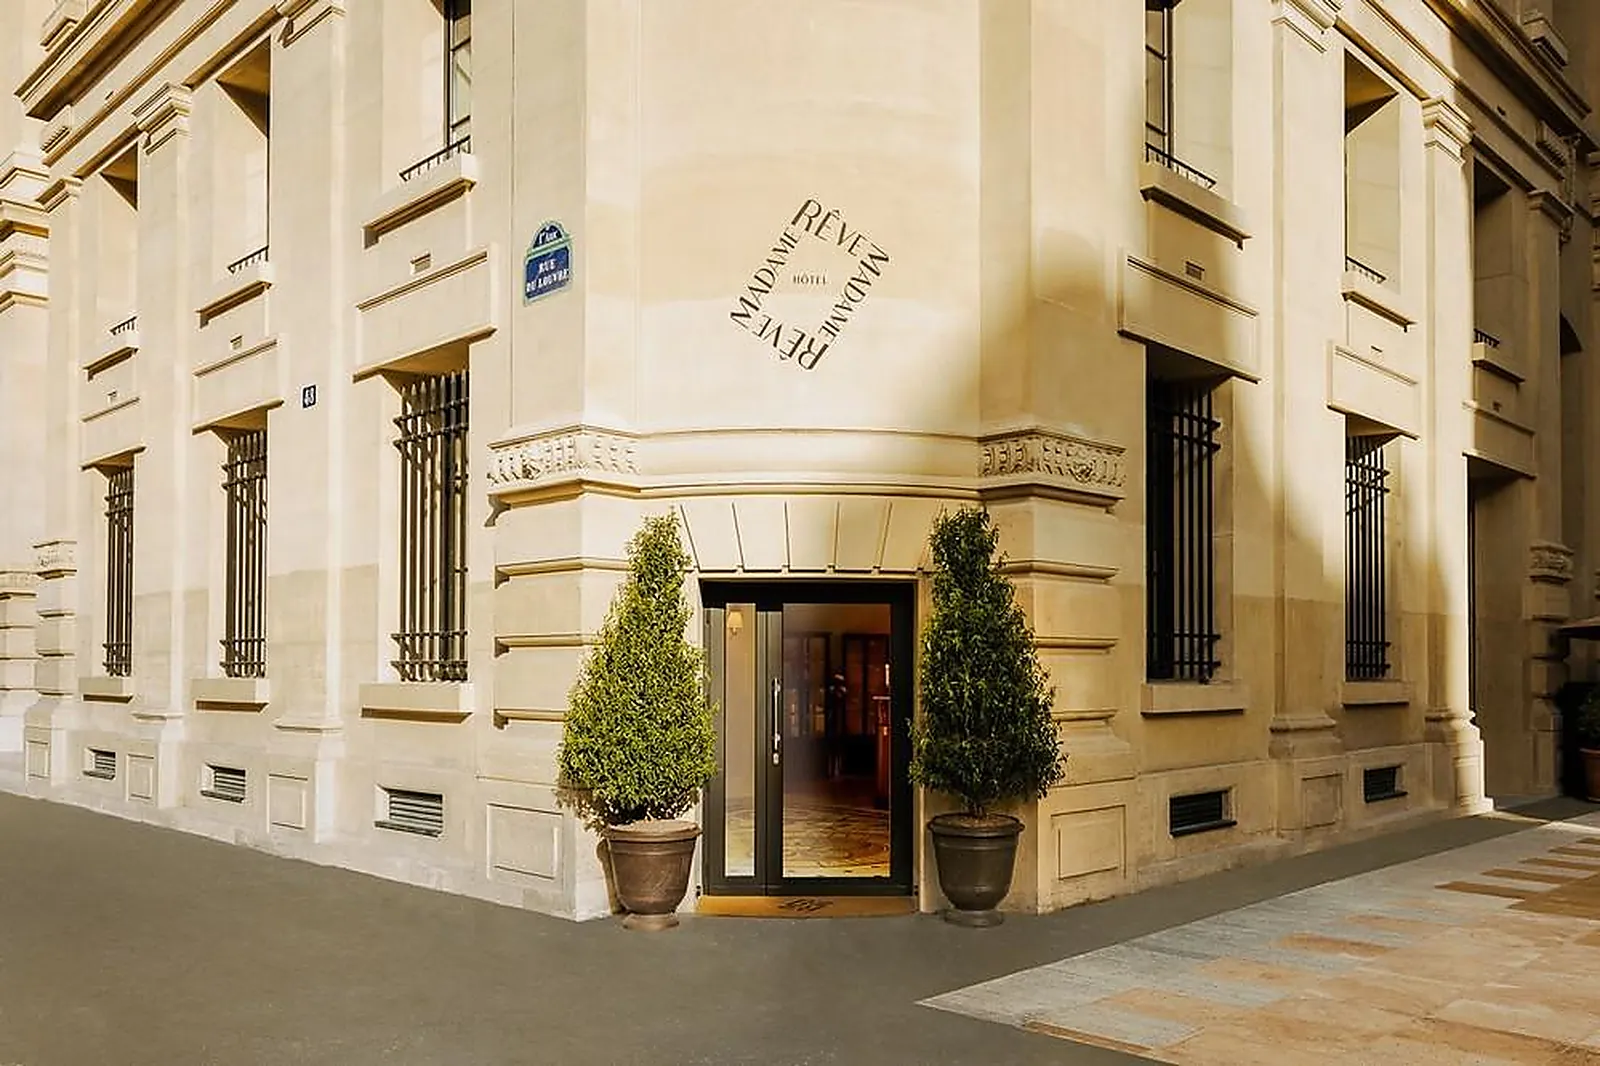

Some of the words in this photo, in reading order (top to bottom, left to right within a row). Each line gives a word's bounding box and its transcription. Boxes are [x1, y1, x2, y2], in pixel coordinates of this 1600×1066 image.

[527, 280, 537, 292] DU
[538, 269, 567, 288] LOUVRE
[539, 259, 556, 274] RUE
[730, 227, 800, 329] MADAME
[791, 199, 868, 257] RÊVE
[818, 243, 889, 342] MADAME
[752, 314, 829, 370] RÊVE
